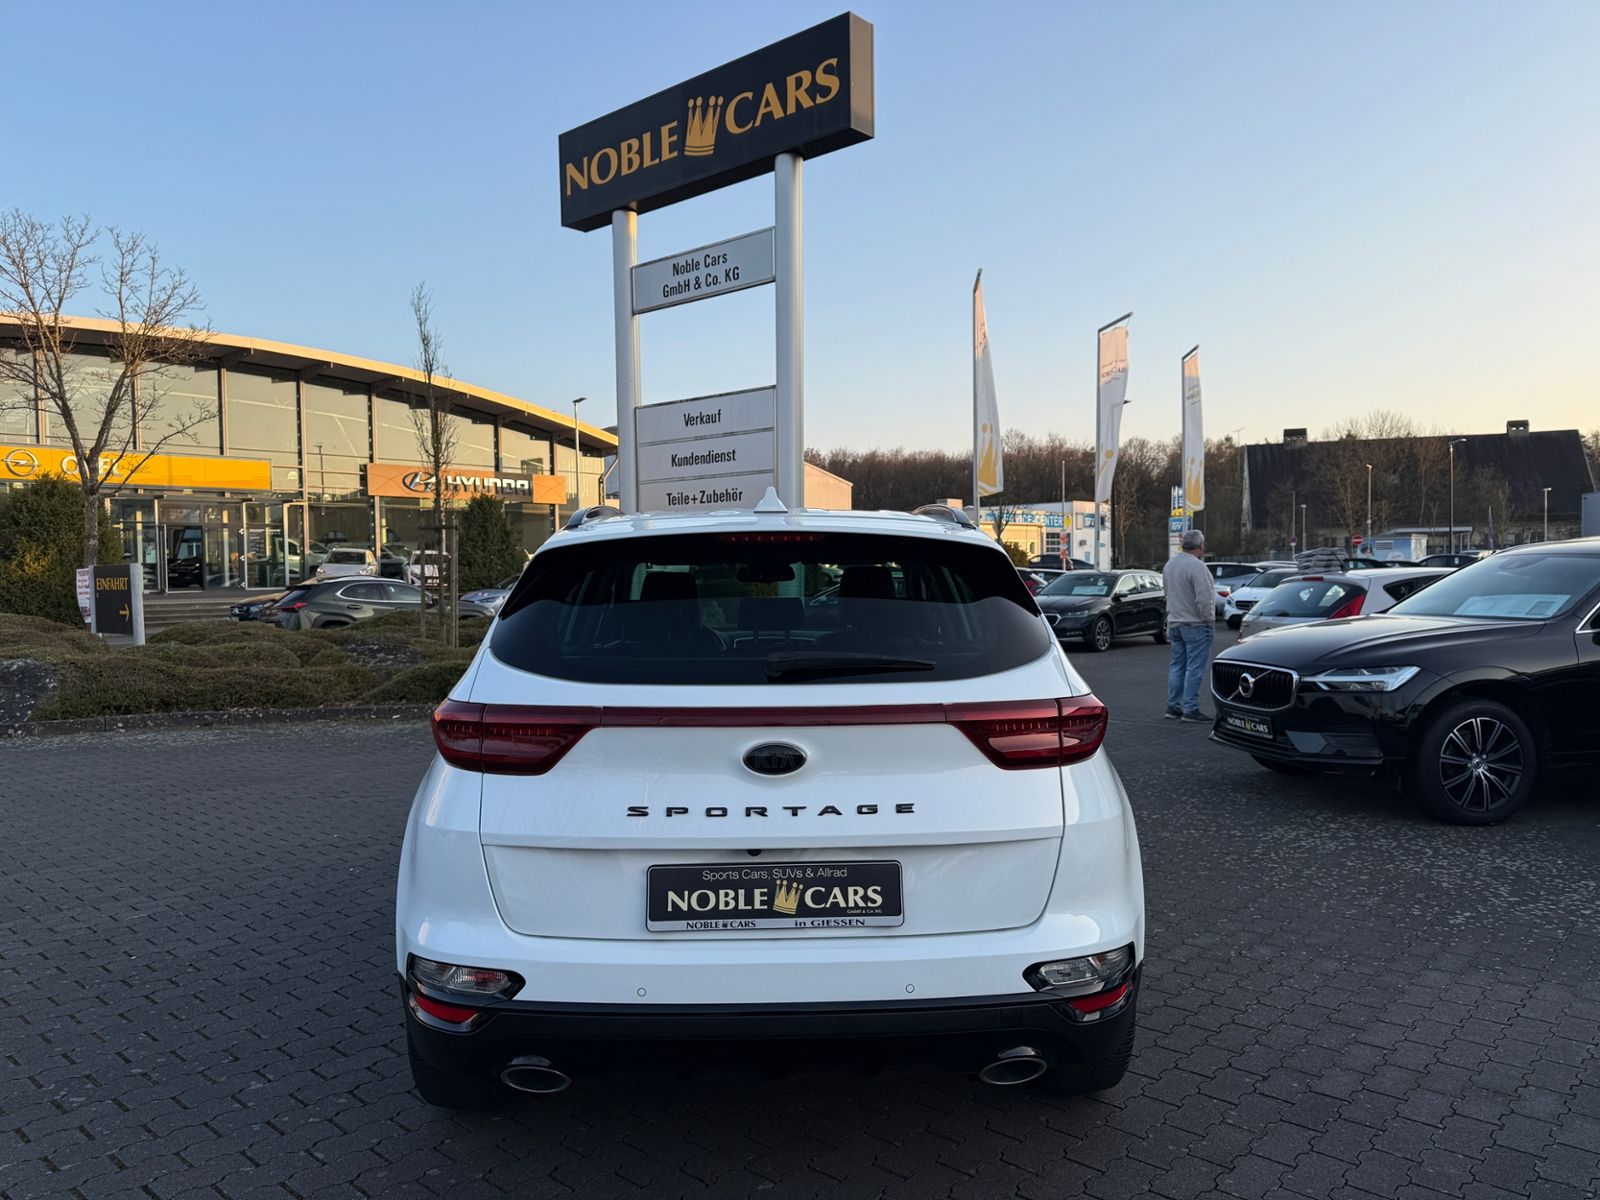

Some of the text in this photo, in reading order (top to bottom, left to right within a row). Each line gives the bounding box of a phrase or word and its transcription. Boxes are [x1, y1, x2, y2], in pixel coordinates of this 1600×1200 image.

[565, 57, 840, 196] NOBLE CARS
[672, 252, 728, 277] Noble Cars
[662, 265, 740, 298] GmbH & Co. KG
[683, 408, 722, 427] Verkauf
[671, 449, 737, 468] Kundendienst
[666, 487, 744, 507] Teile+Zubehör
[96, 577, 129, 591] EINFAHRT
[1251, 722, 1268, 732] CARS
[626, 803, 916, 818] SPORTAGE
[702, 867, 848, 882] Sports Cars, SUVs & Allrad
[667, 885, 883, 912] NOBLE CARS
[686, 918, 866, 930] NOBLE CARS in GIESSEN
